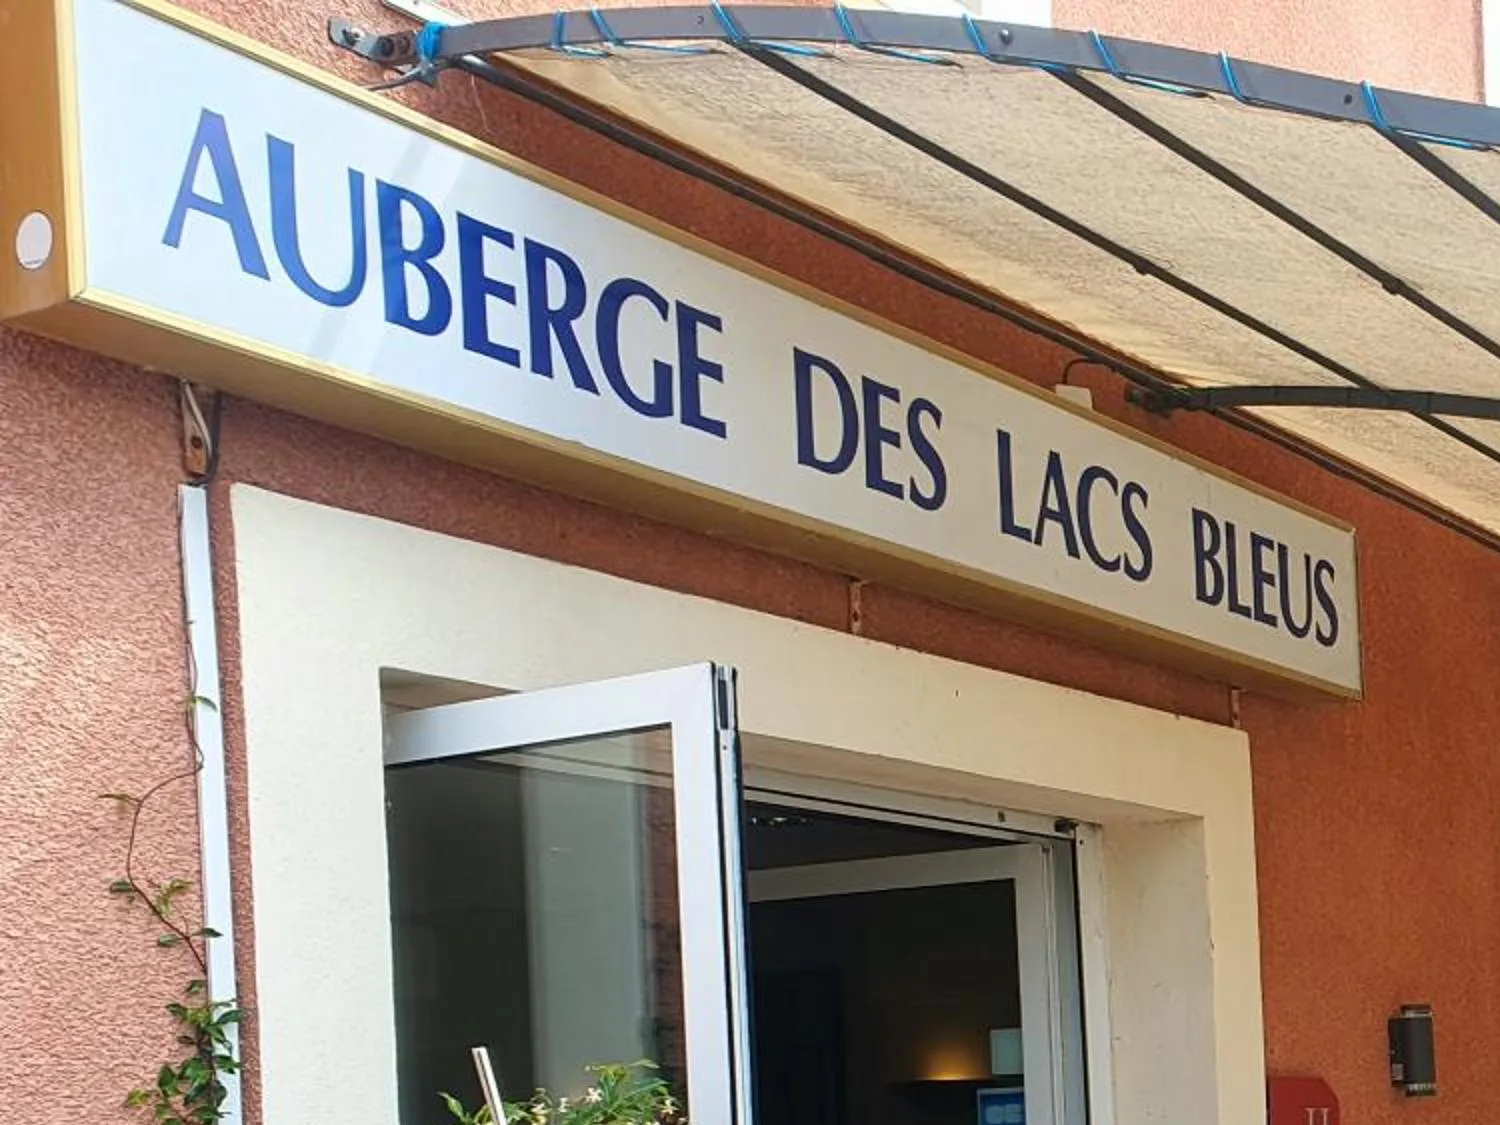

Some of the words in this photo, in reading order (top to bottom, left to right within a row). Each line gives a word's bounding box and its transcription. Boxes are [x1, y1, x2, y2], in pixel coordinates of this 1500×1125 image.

[162, 108, 728, 438] AUBERGE
[793, 345, 947, 511] DES
[998, 429, 1153, 582] LACS
[1192, 508, 1338, 647] BLEUS
